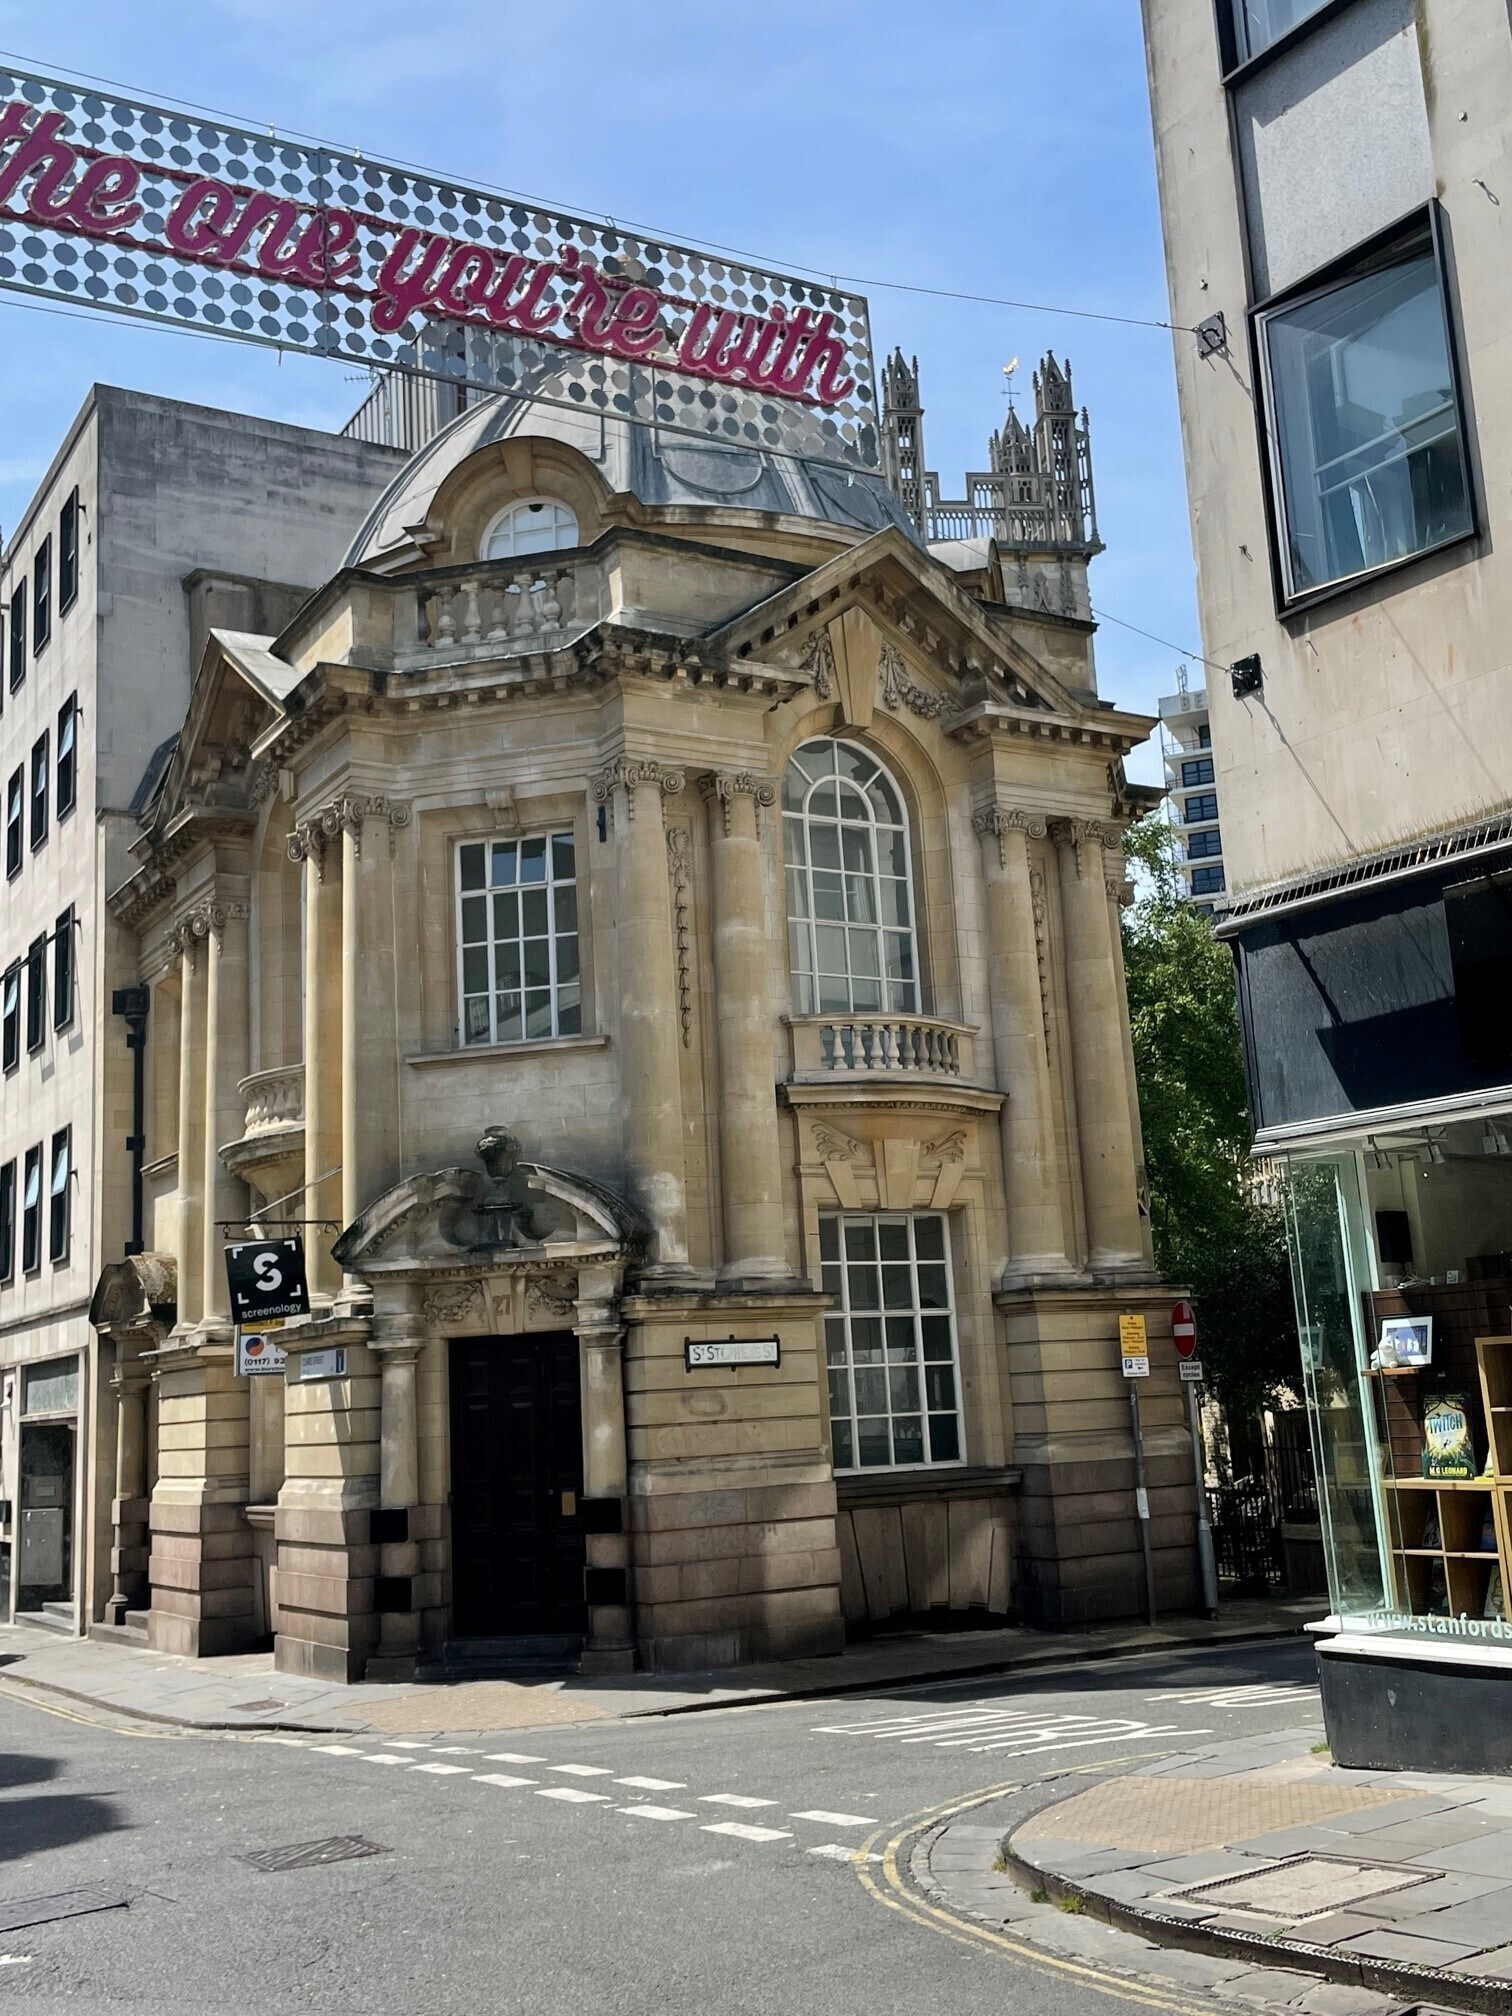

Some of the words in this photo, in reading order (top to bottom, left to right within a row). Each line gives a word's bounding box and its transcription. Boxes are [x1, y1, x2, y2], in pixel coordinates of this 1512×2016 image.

[165, 177, 361, 284] one
[370, 226, 666, 356] you're
[677, 301, 856, 403] with
[241, 1303, 302, 1319] screenology
[244, 1357, 270, 1367] (0117)
[1426, 1413, 1463, 1434] TWITCH
[1441, 1466, 1468, 1475] LEONARD
[809, 1708, 1215, 1757] ENTRY
